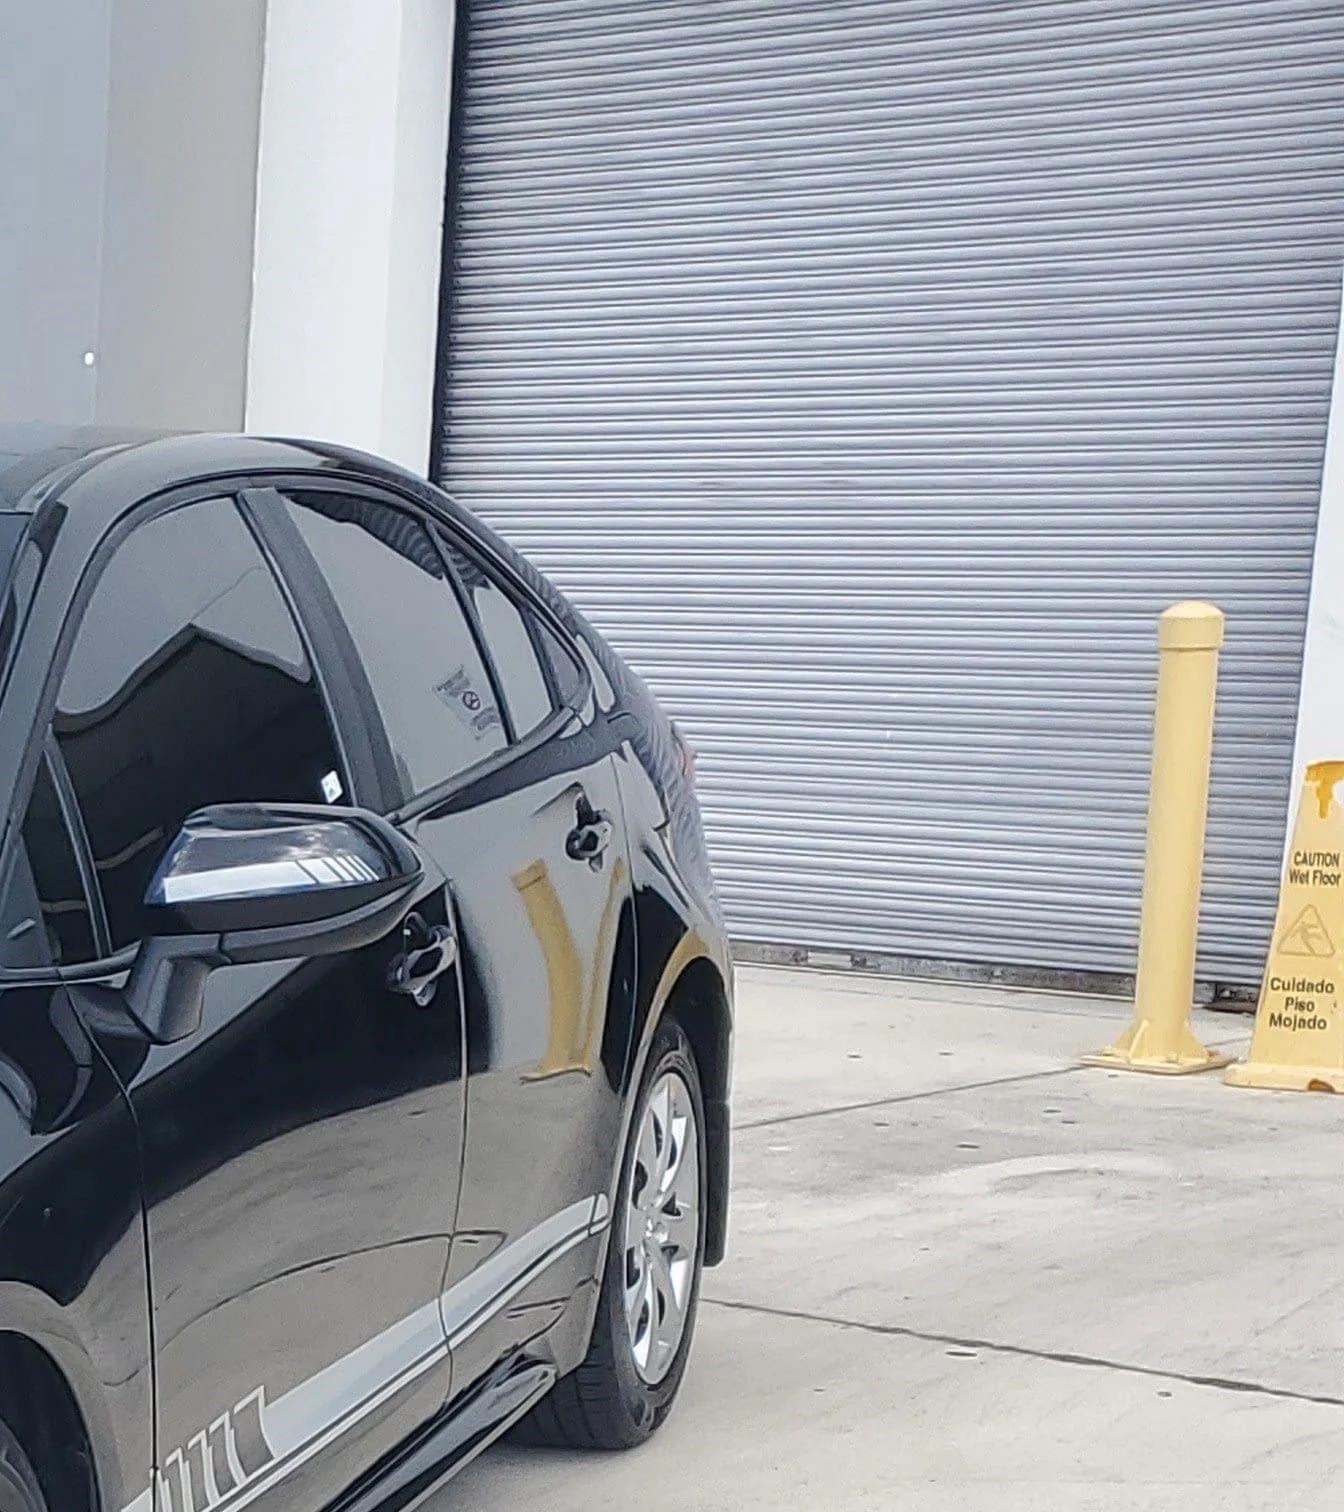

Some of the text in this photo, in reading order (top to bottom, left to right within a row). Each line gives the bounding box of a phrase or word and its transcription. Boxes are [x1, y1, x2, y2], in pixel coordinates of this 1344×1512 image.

[1294, 851, 1340, 868] CAUTION
[1289, 869, 1342, 887] Wet Floor
[1270, 977, 1335, 994] Cuidado
[1284, 997, 1315, 1013] Piso
[1269, 1013, 1327, 1031] Mojado
